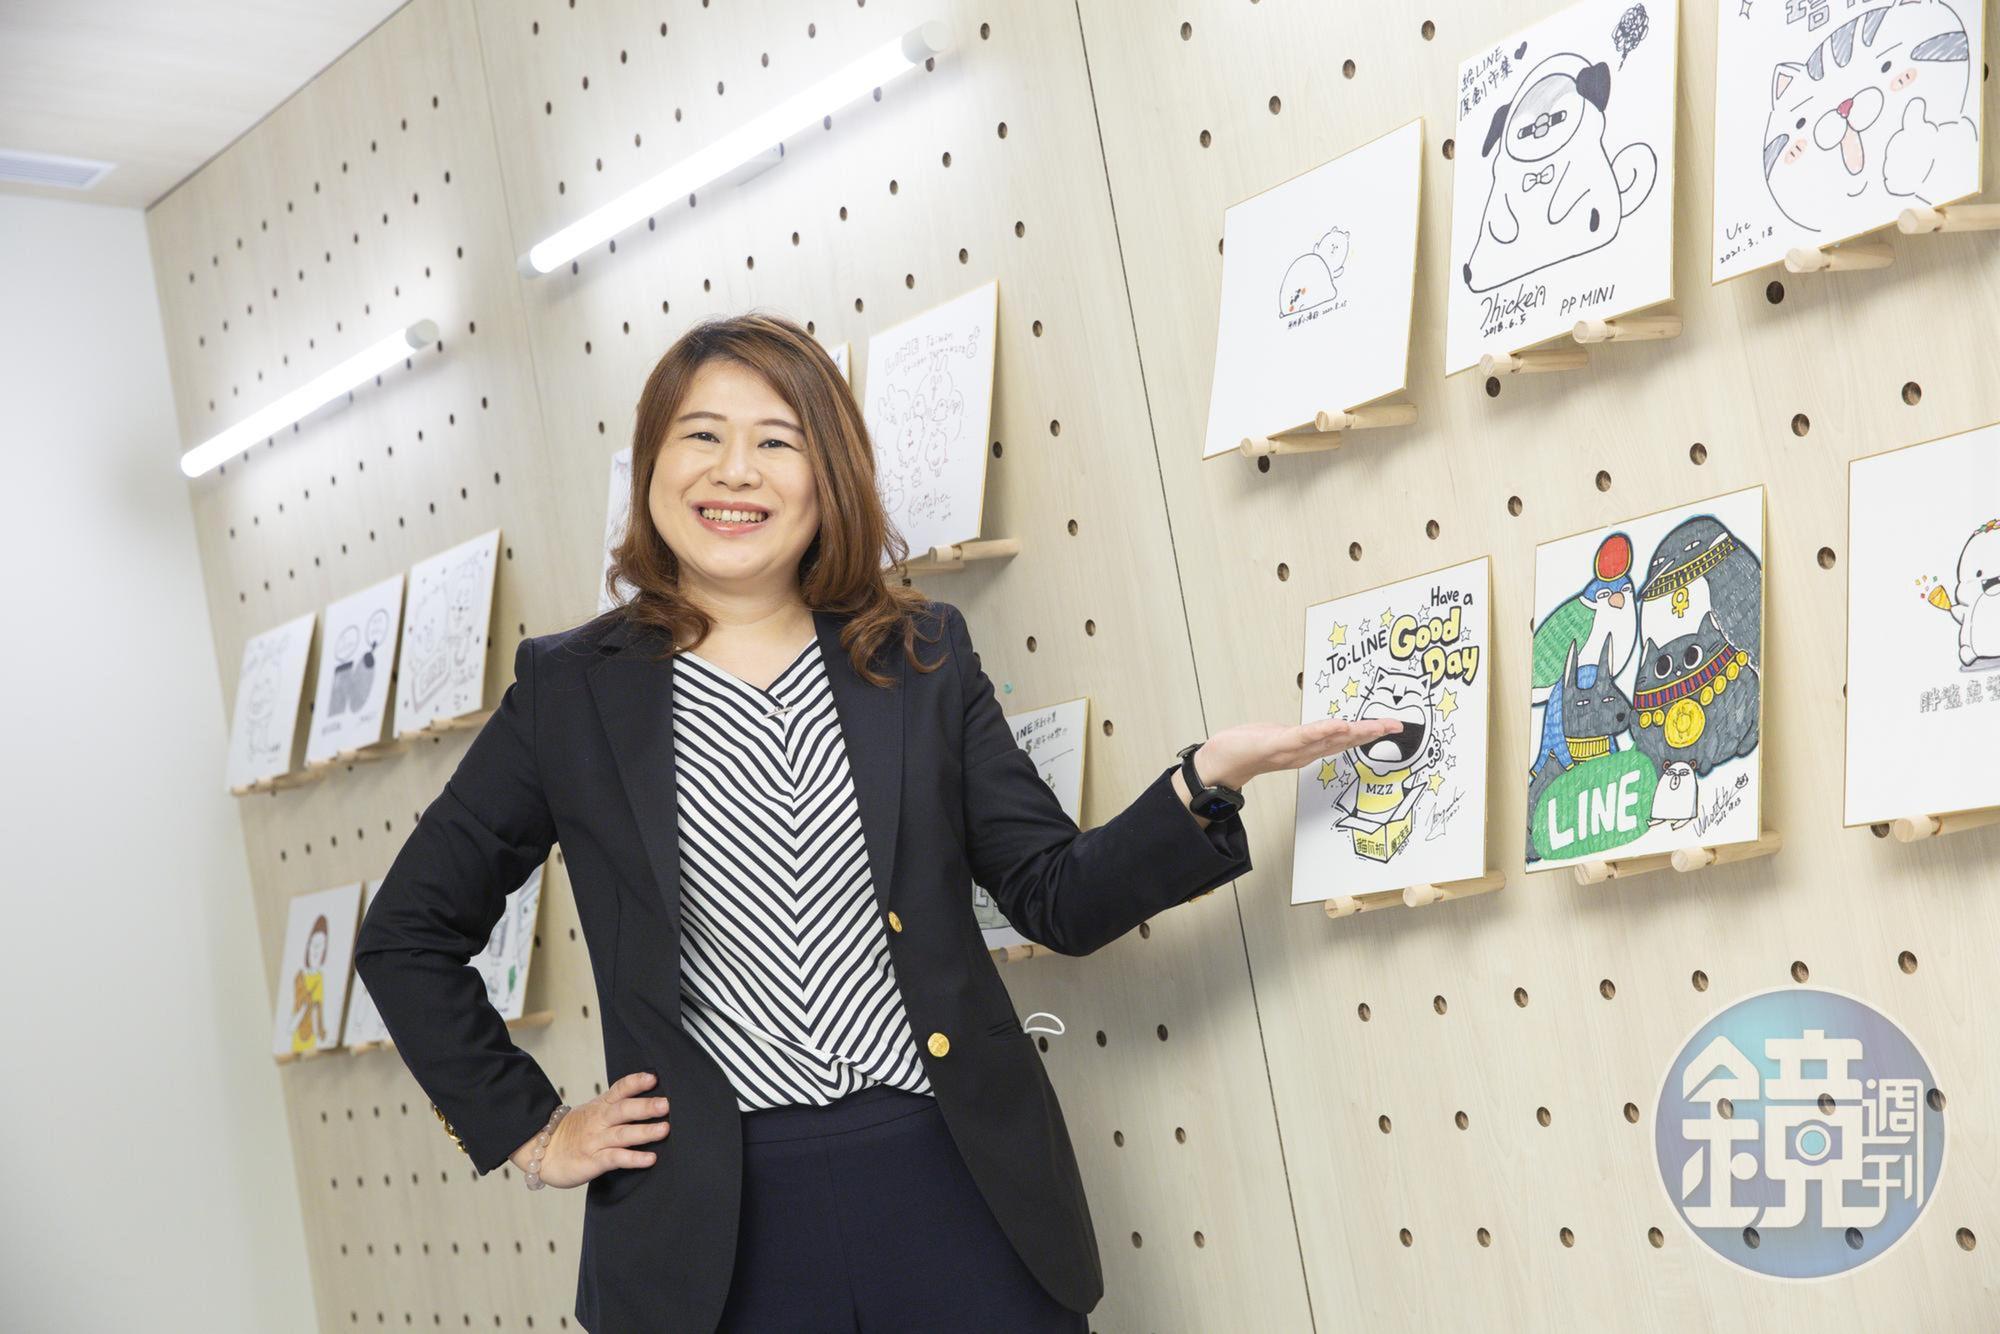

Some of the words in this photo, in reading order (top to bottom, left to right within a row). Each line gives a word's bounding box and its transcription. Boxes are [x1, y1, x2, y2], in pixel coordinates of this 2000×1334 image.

[1579, 284, 1615, 308] MINI
[1430, 585, 1459, 607] Have
[1462, 592, 1473, 605] a
[1389, 605, 1462, 661] Good
[1421, 645, 1480, 690] Day
[1366, 783, 1393, 795] MZZ
[1548, 769, 1641, 850] LINE
